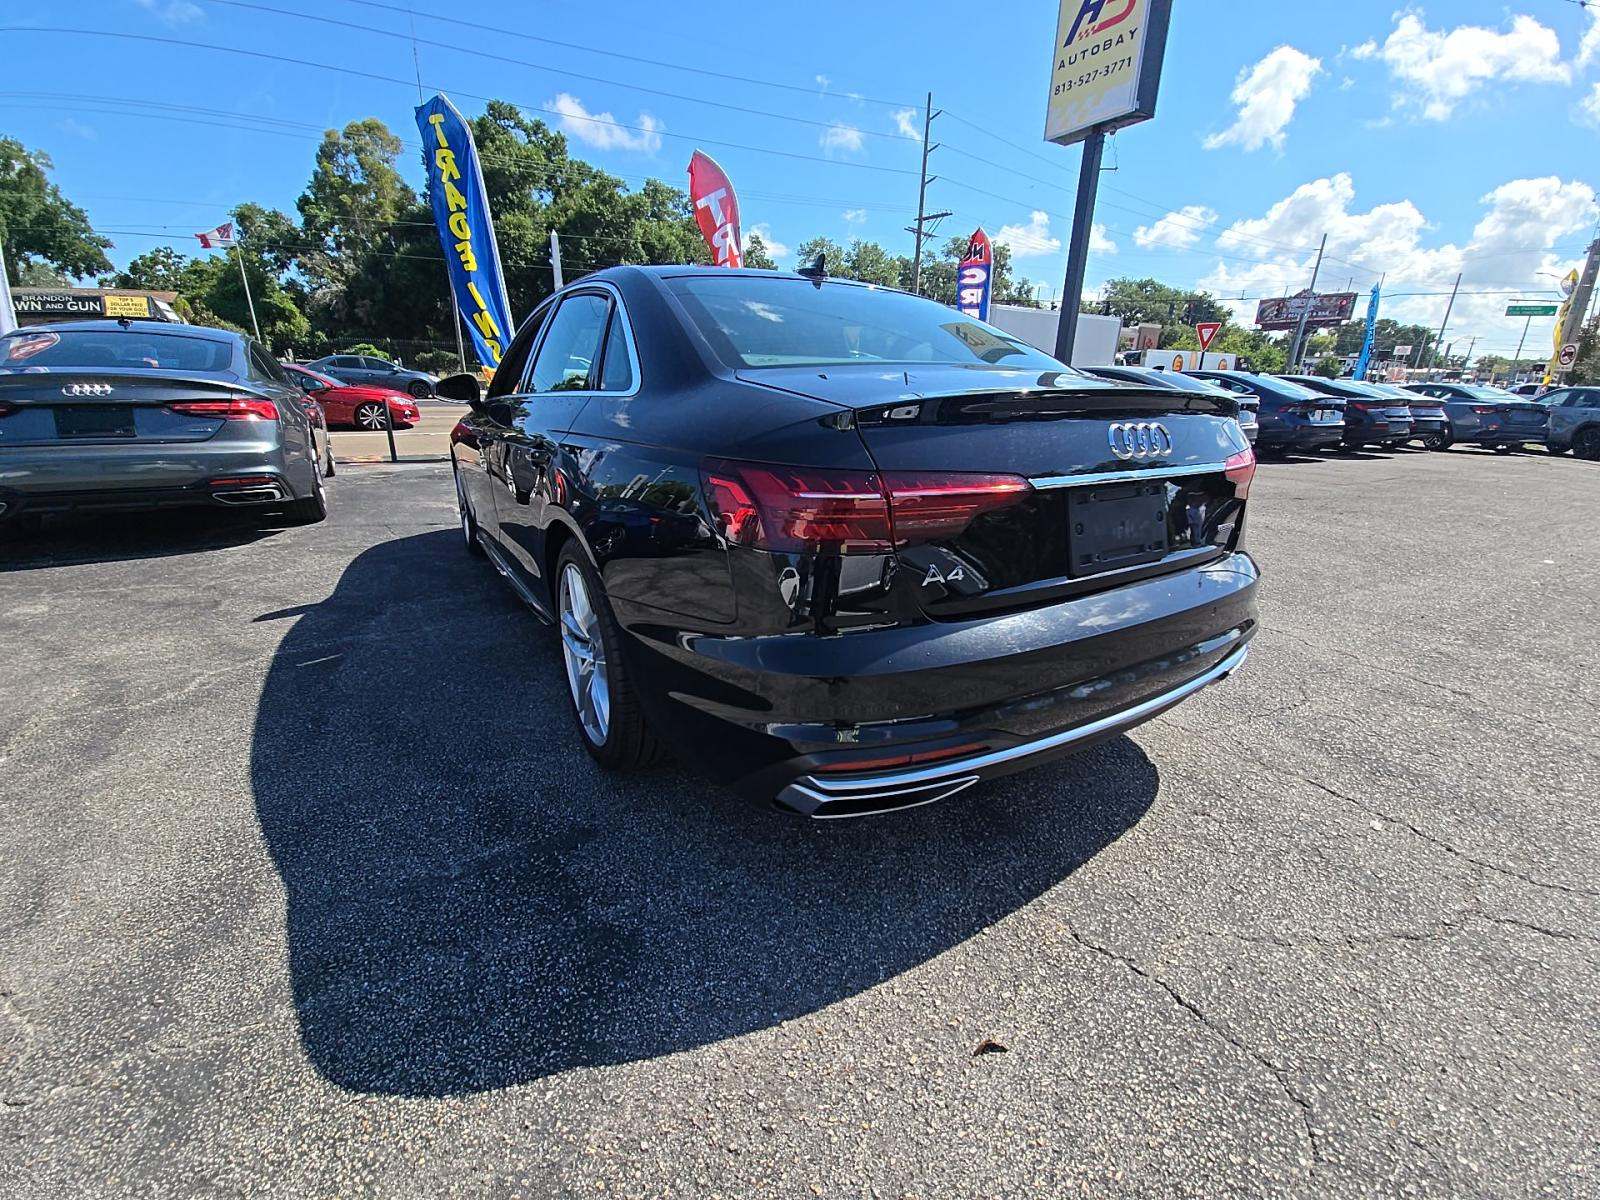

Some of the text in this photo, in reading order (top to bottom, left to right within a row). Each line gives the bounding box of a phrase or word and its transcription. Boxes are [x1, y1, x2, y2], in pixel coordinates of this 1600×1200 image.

[1058, 27, 1138, 70] AUTOBAY
[1054, 56, 1132, 96] 813-527-3771
[67, 301, 101, 311] GUN
[921, 564, 964, 586] A4
